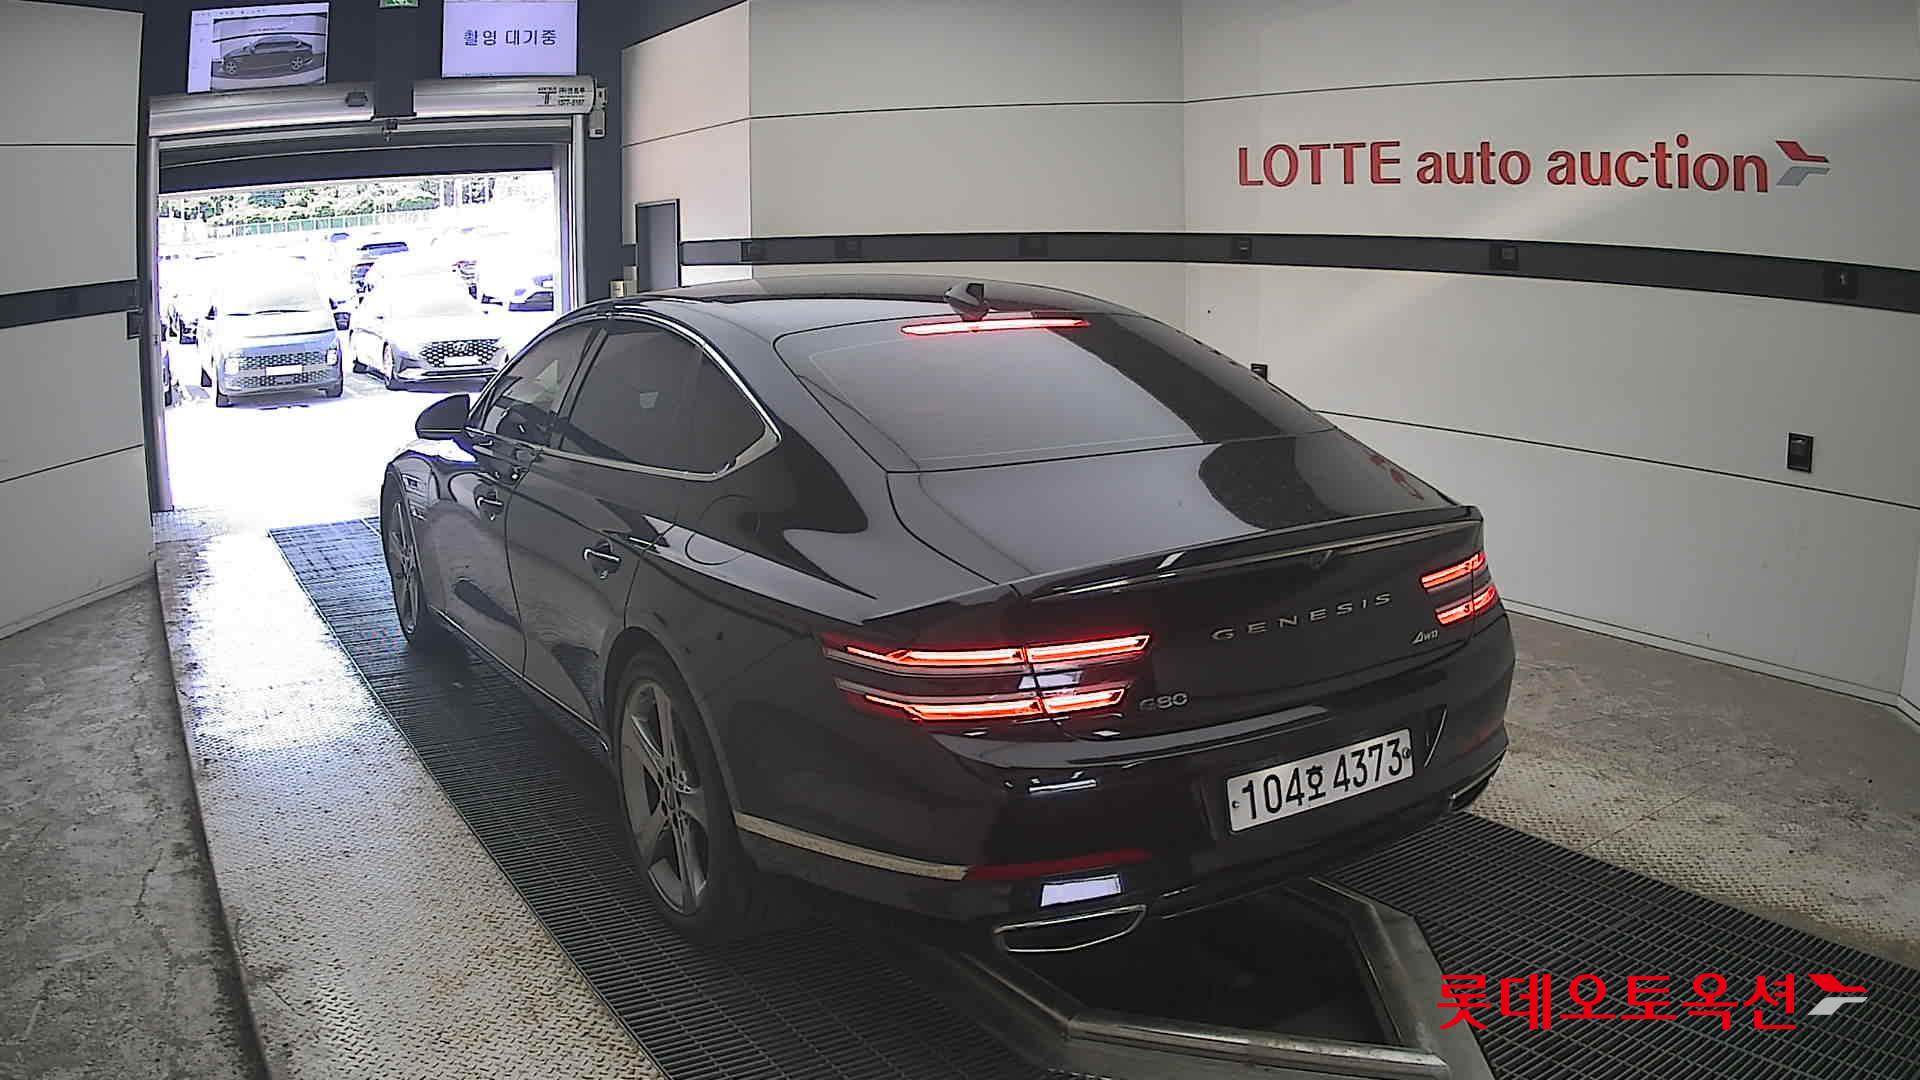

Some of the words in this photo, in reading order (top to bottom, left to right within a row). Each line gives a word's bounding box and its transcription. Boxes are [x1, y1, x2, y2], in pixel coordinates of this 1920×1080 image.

[505, 29, 557, 46] 대기중
[1237, 140, 1401, 187] LOTTE
[1416, 141, 1532, 185] auto
[1547, 134, 1769, 193] auction
[1210, 593, 1391, 641] GENESIS
[1242, 765, 1326, 820] 104호
[1333, 737, 1402, 792] 4373
